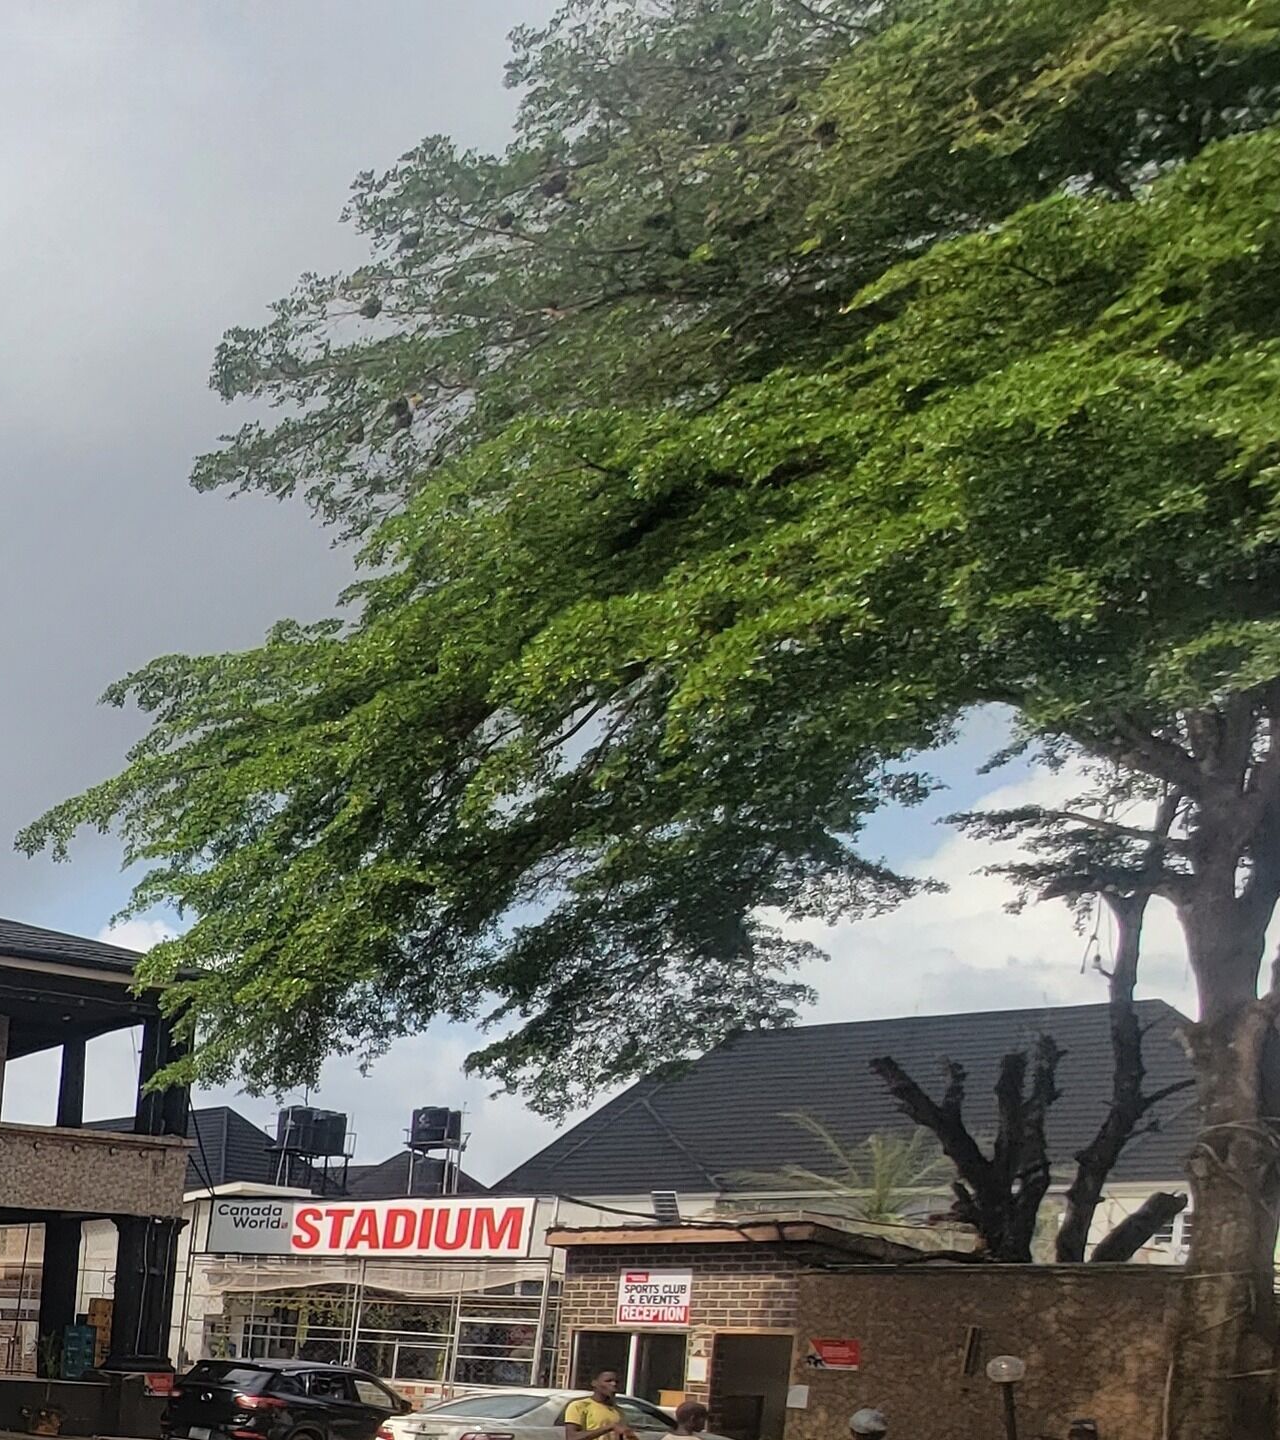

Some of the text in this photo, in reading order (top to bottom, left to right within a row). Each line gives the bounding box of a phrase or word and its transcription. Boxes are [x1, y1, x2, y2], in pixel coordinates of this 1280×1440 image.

[218, 1204, 283, 1216] Canada
[233, 1216, 281, 1229] World
[292, 1207, 525, 1250] STADIUM
[624, 1284, 687, 1294] SPORTS CLUB
[628, 1295, 681, 1305] & EVENTS
[621, 1306, 686, 1322] RECEPTION
